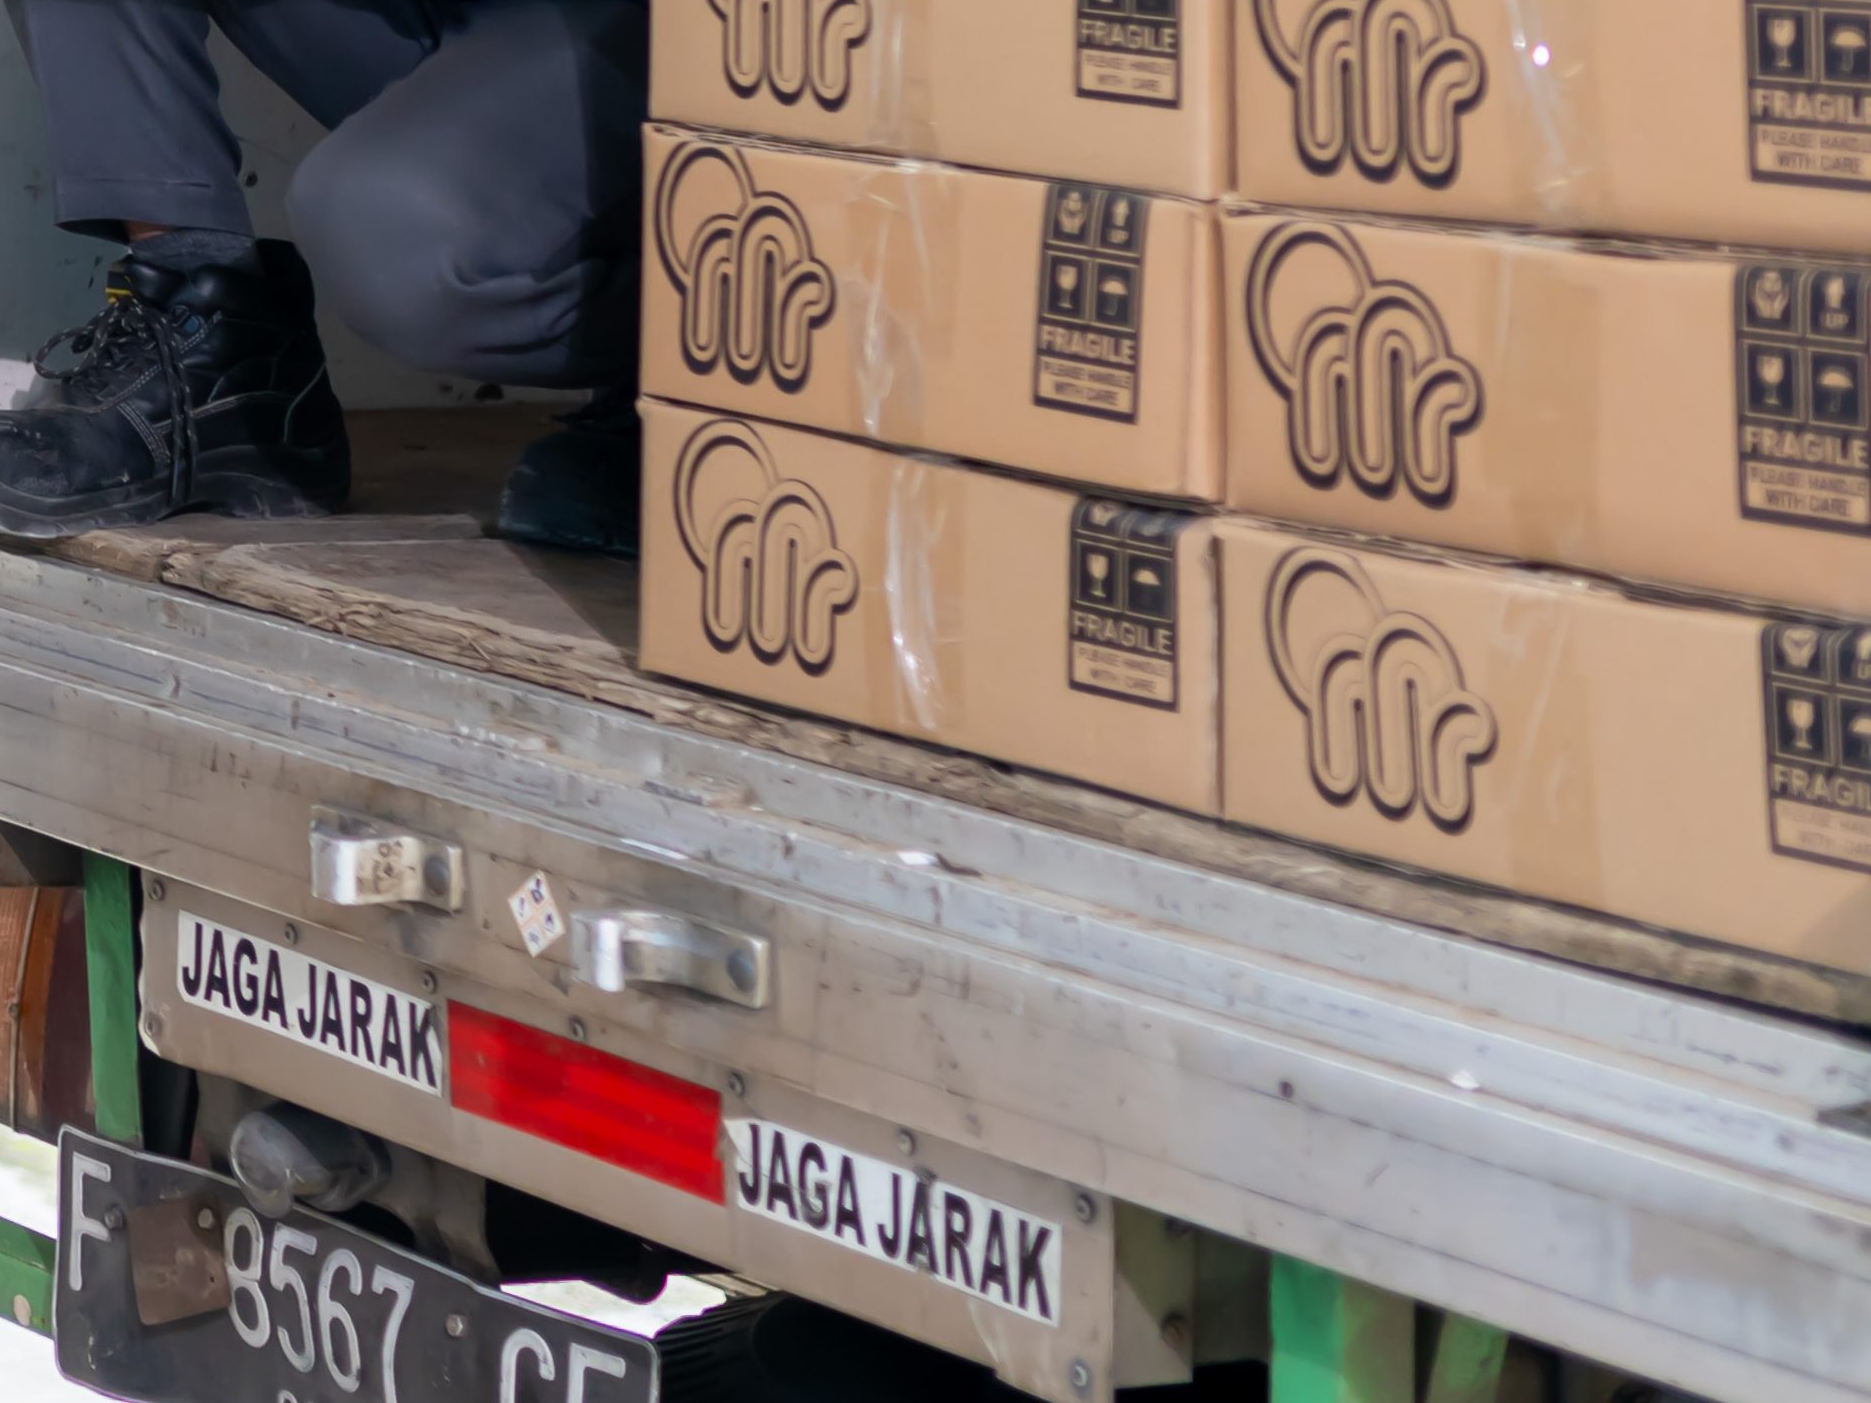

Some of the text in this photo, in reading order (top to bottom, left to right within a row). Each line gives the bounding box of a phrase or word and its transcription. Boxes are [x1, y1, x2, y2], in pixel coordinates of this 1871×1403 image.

[1078, 18, 1177, 53] FRAGILE
[1759, 130, 1815, 148] PLEASE
[1777, 151, 1863, 174] WITH CARE
[1039, 325, 1135, 365] FRAGILE
[1743, 426, 1869, 468] FRAGILE
[1749, 465, 1867, 495] PLEASE HANDLE
[1765, 489, 1851, 517] WITH CARE
[1071, 609, 1173, 655] FRAGILE
[181, 921, 438, 1089] JAGA JARAK
[70, 1151, 112, 1292] F
[738, 1122, 1053, 1321] JAGA JARAK
[223, 1206, 414, 1403] 8567
